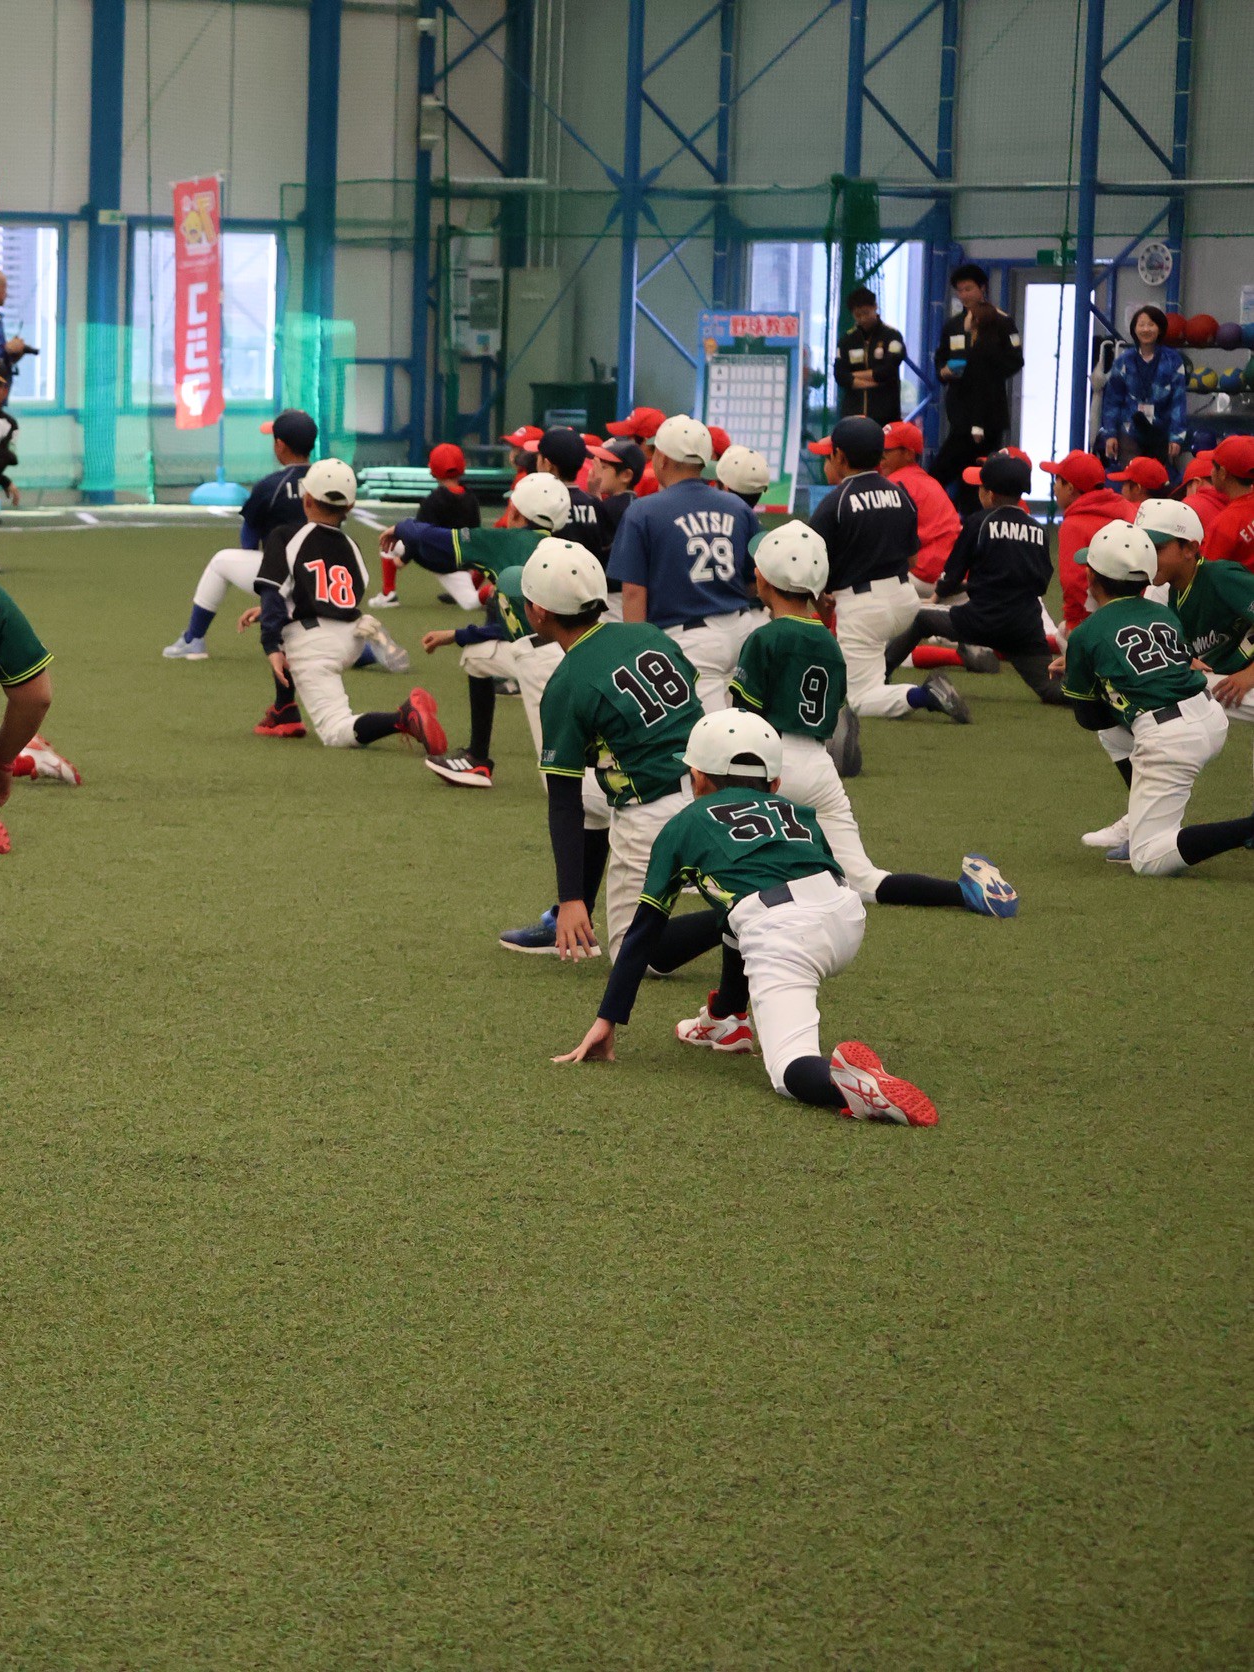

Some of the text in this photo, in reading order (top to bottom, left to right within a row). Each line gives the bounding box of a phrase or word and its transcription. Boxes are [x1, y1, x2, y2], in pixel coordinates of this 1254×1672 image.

[849, 490, 902, 513] AYUMU
[674, 511, 735, 537] TATSU
[989, 521, 1044, 546] KANATO
[686, 537, 736, 583] 29
[1115, 622, 1192, 676] 20
[612, 650, 690, 728] 18
[799, 665, 829, 727] 9
[707, 800, 813, 843] 51
